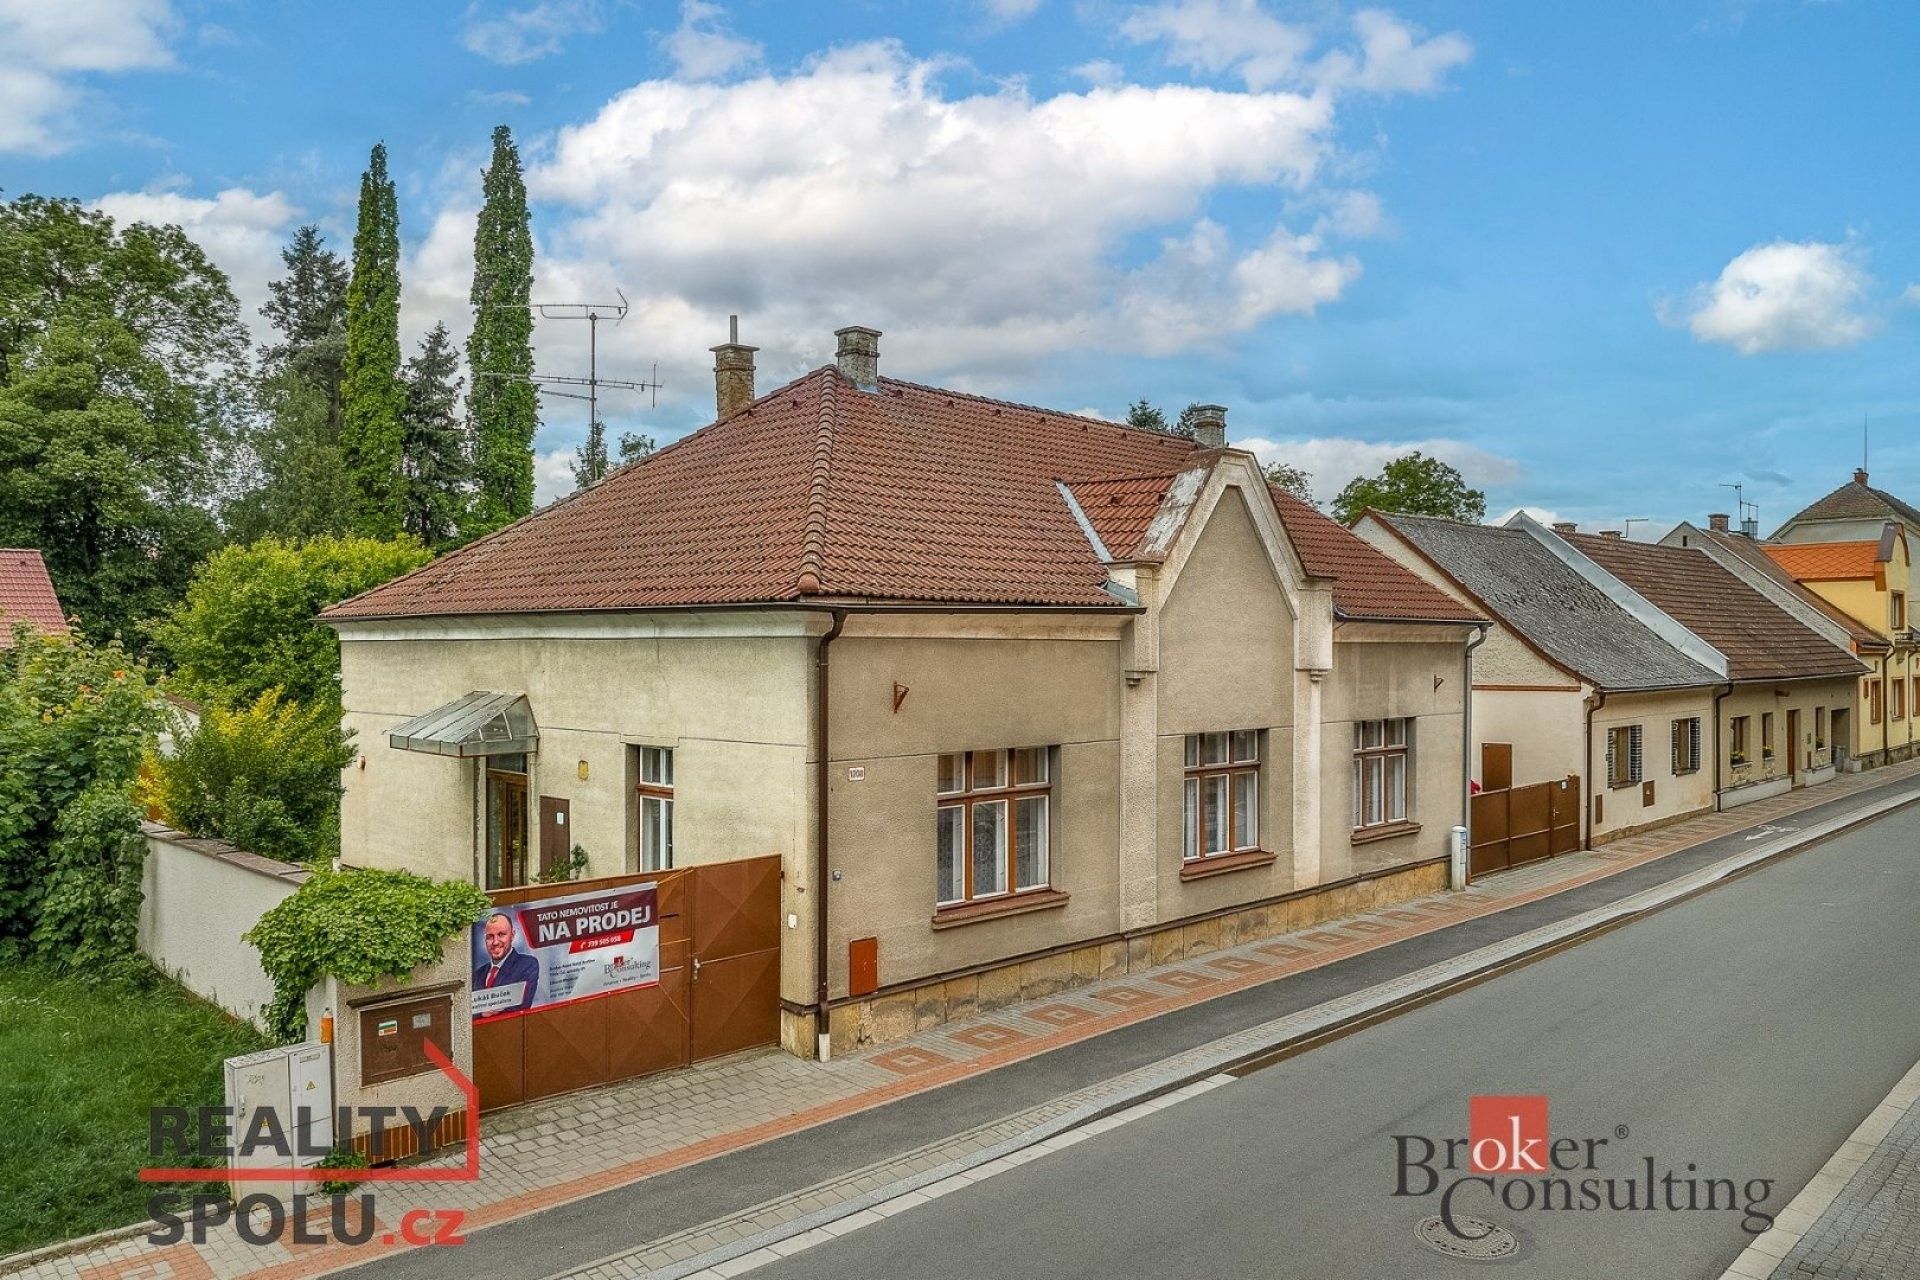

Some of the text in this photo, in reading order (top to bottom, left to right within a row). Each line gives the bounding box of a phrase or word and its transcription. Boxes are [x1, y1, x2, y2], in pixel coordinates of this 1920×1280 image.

[537, 901, 619, 922] TATO NEMOVITOST JE
[538, 905, 651, 943] NA PRODEJ
